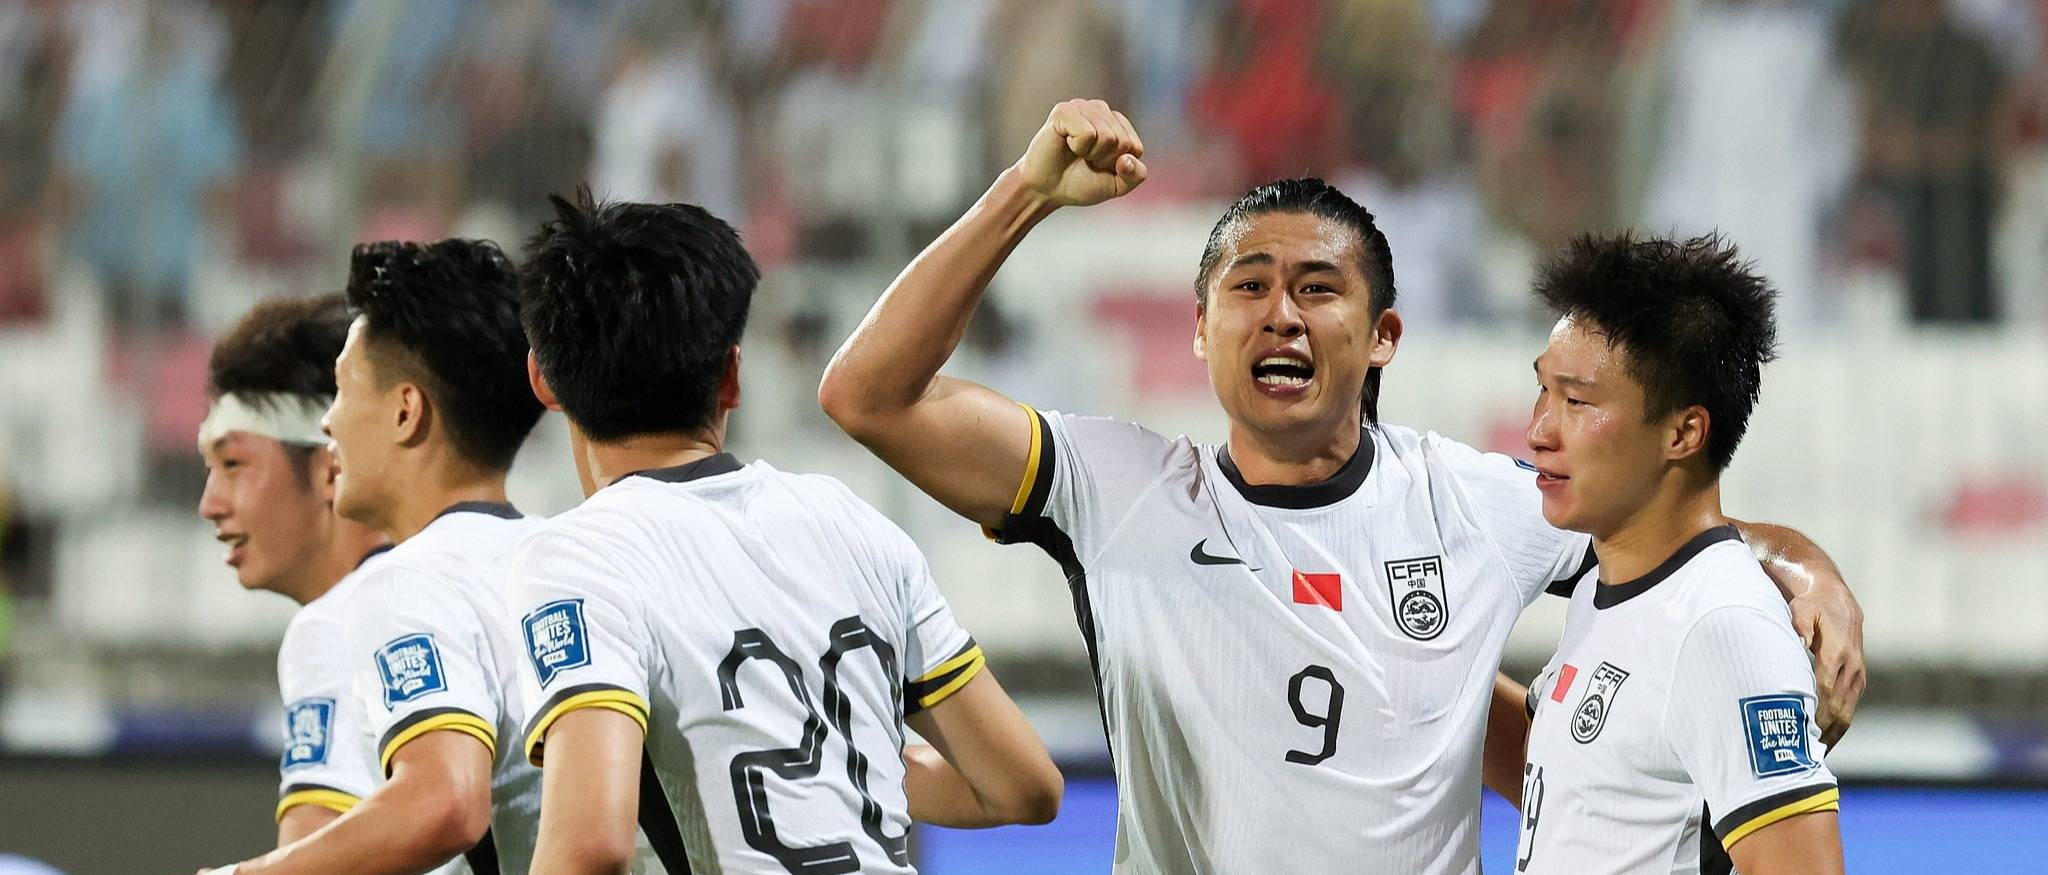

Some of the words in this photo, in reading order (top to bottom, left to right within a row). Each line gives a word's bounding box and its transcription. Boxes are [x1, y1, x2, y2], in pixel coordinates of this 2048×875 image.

[1391, 562, 1438, 581] CFA
[1408, 578, 1426, 589] 中国
[1594, 666, 1623, 688] CFA
[1285, 665, 1345, 766] 9
[1758, 708, 1797, 721] FOOTBALL
[1760, 719, 1798, 736] UNITES
[717, 615, 909, 875] 20
[1760, 735, 1777, 750] the
[1777, 734, 1801, 749] World
